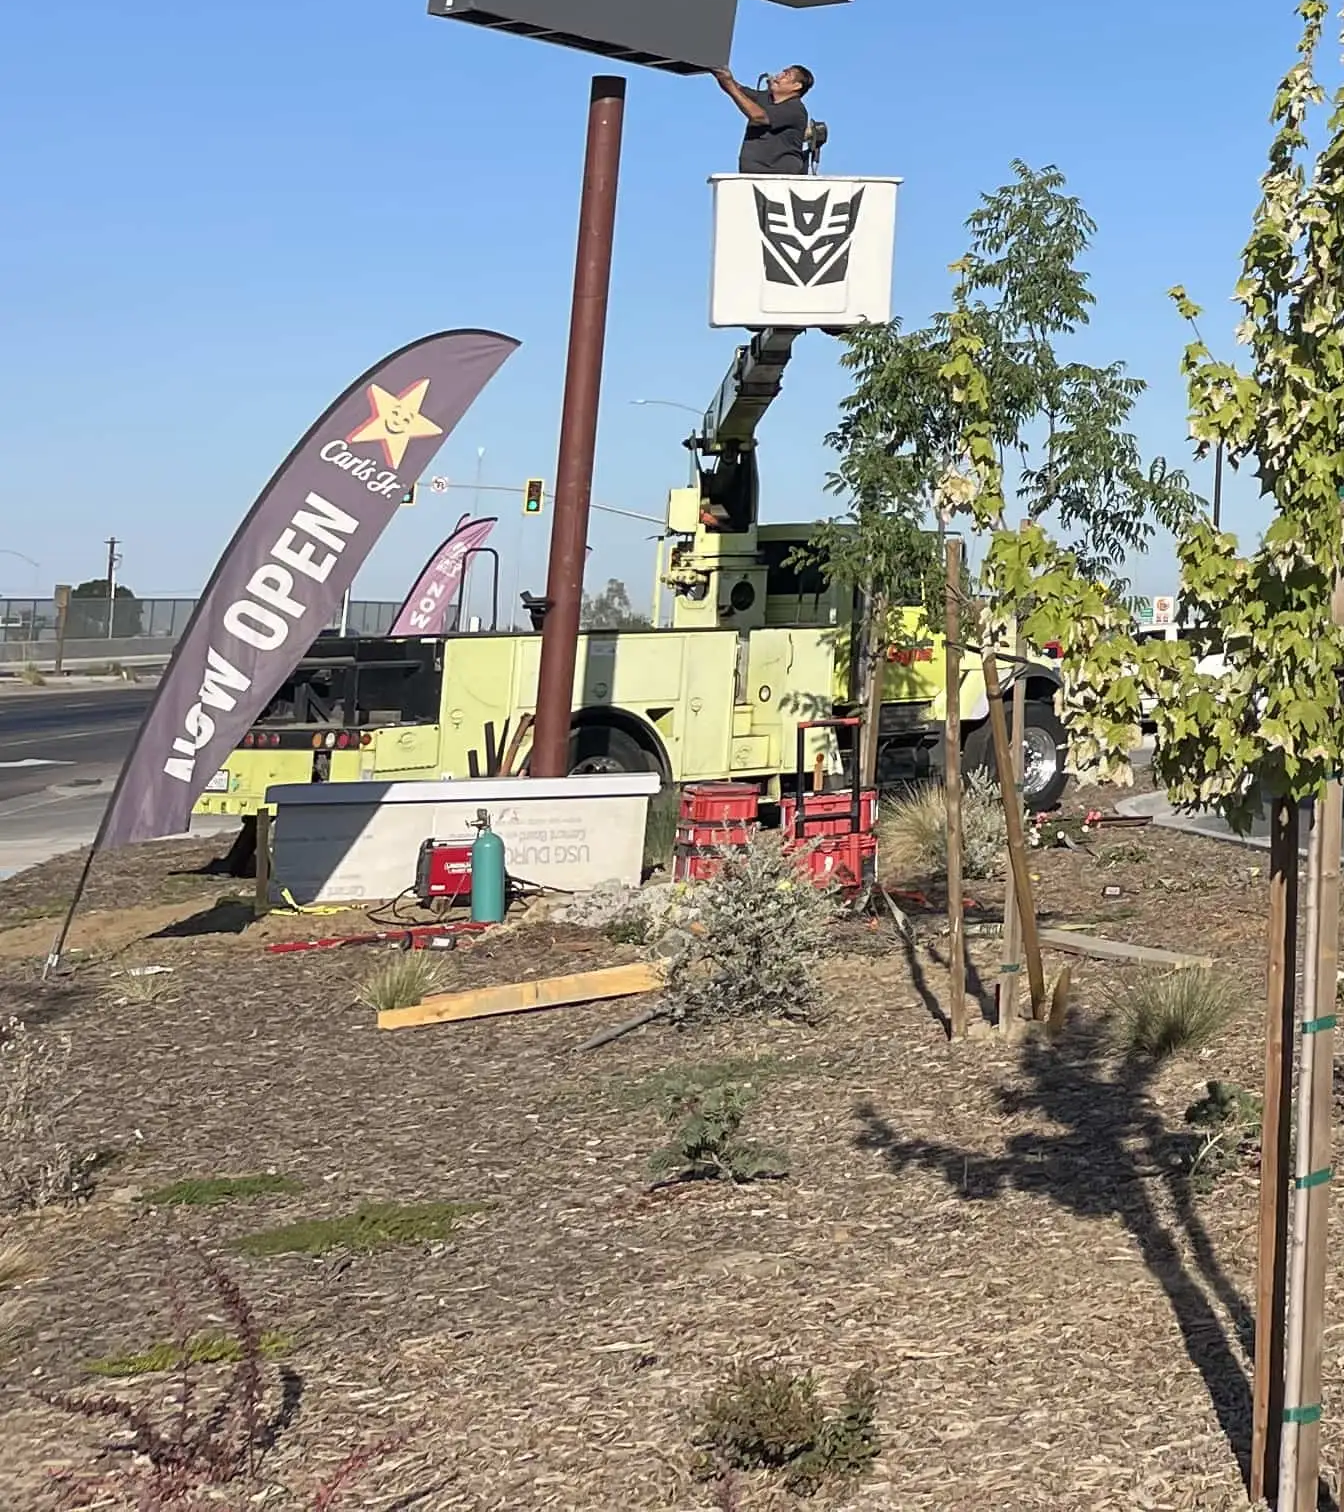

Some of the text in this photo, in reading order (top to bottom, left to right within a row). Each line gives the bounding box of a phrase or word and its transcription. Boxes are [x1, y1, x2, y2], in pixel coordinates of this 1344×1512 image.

[320, 439, 401, 499] Carl's Jr.
[222, 491, 360, 652] OPEN
[408, 581, 446, 630] NOW
[555, 844, 590, 864] USG
